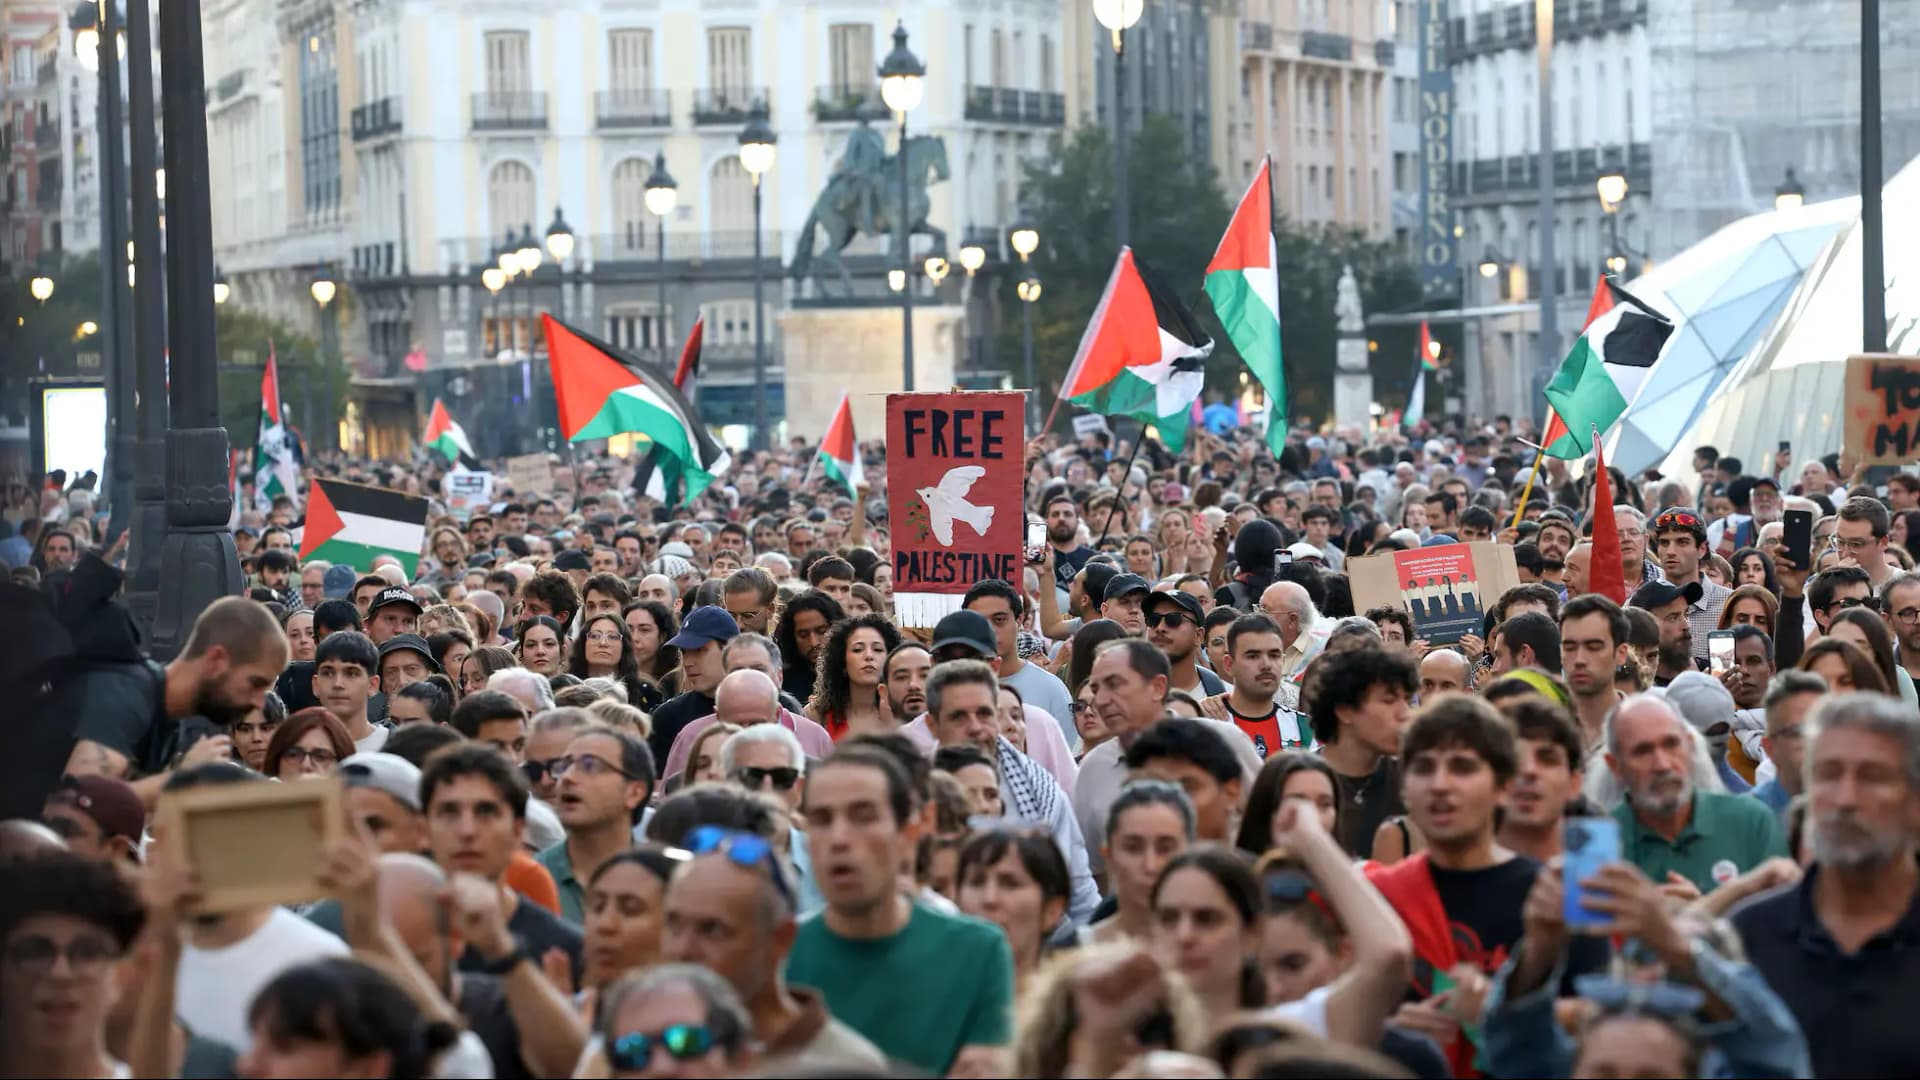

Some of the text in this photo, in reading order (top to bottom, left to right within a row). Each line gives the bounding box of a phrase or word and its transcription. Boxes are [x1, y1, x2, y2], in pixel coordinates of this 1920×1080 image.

[1424, 90, 1450, 266] MODERNO
[903, 409, 1005, 459] FREE
[896, 550, 1016, 586] PALESTINE
